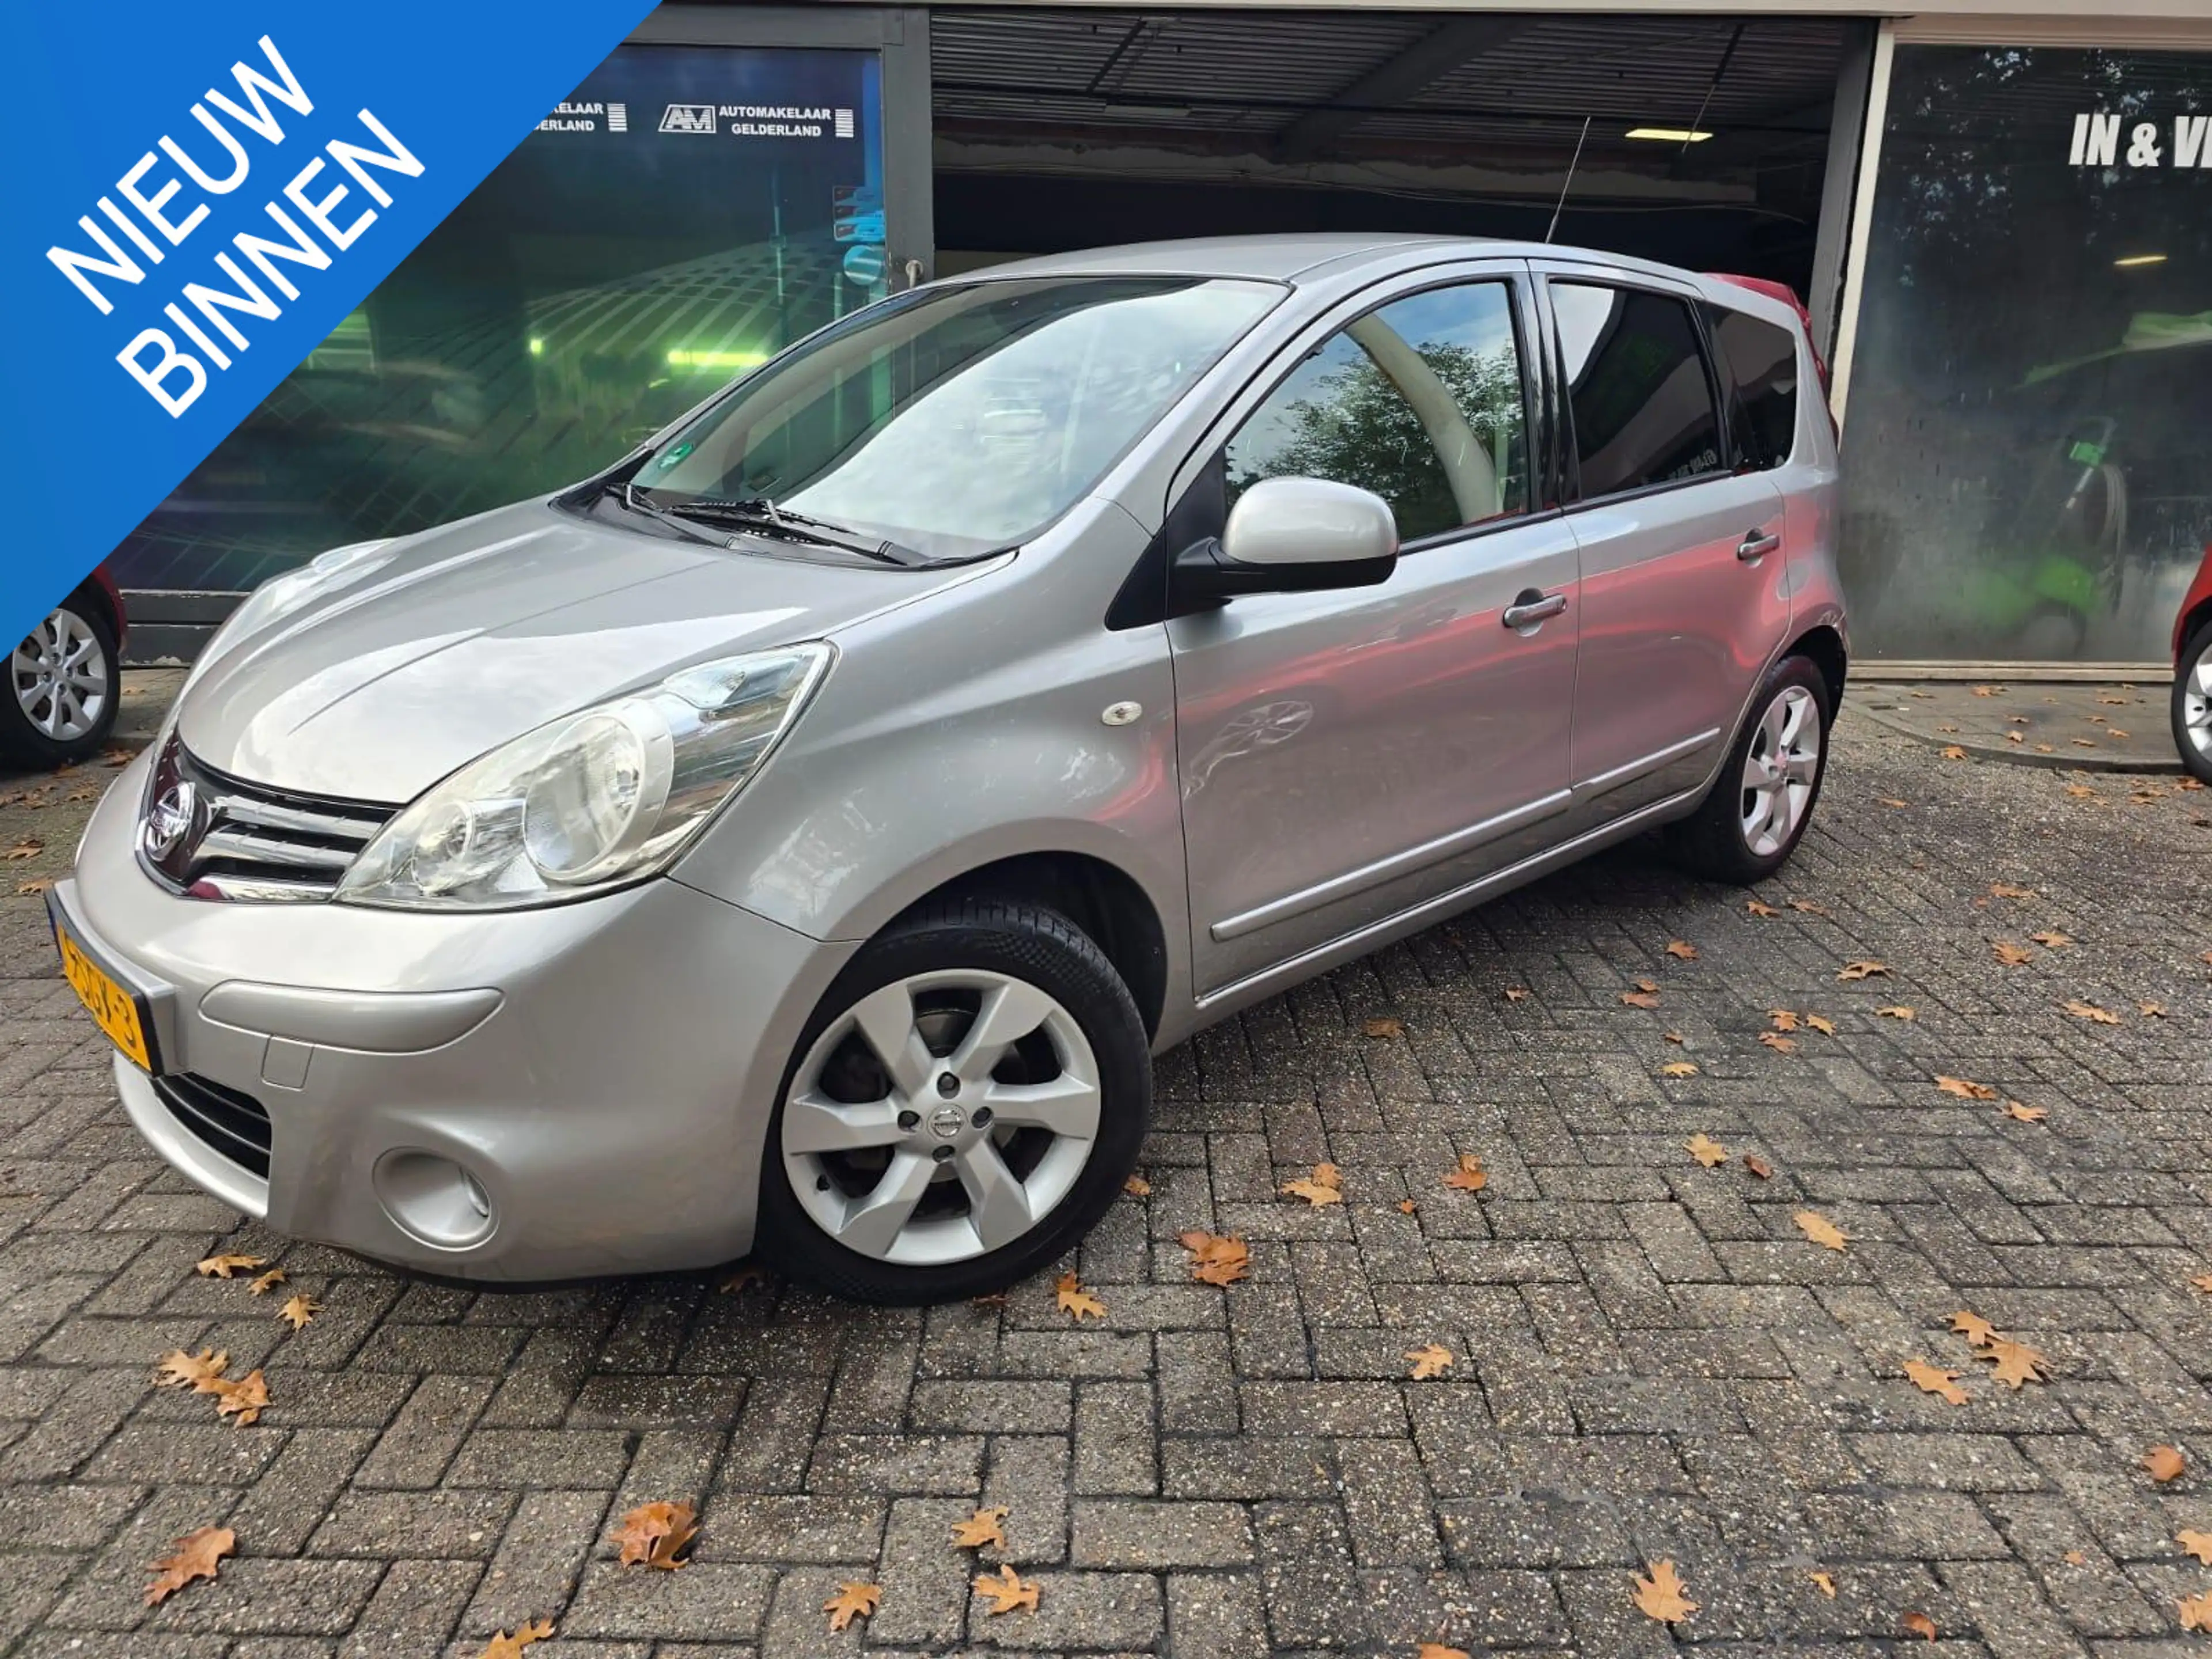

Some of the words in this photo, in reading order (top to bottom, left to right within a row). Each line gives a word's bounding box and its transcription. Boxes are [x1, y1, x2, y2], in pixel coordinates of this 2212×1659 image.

[718, 105, 832, 120] AUTOMAKELAAR
[730, 122, 822, 137] GELDERLAND
[2069, 113, 2122, 165] IN
[2126, 122, 2162, 167] &
